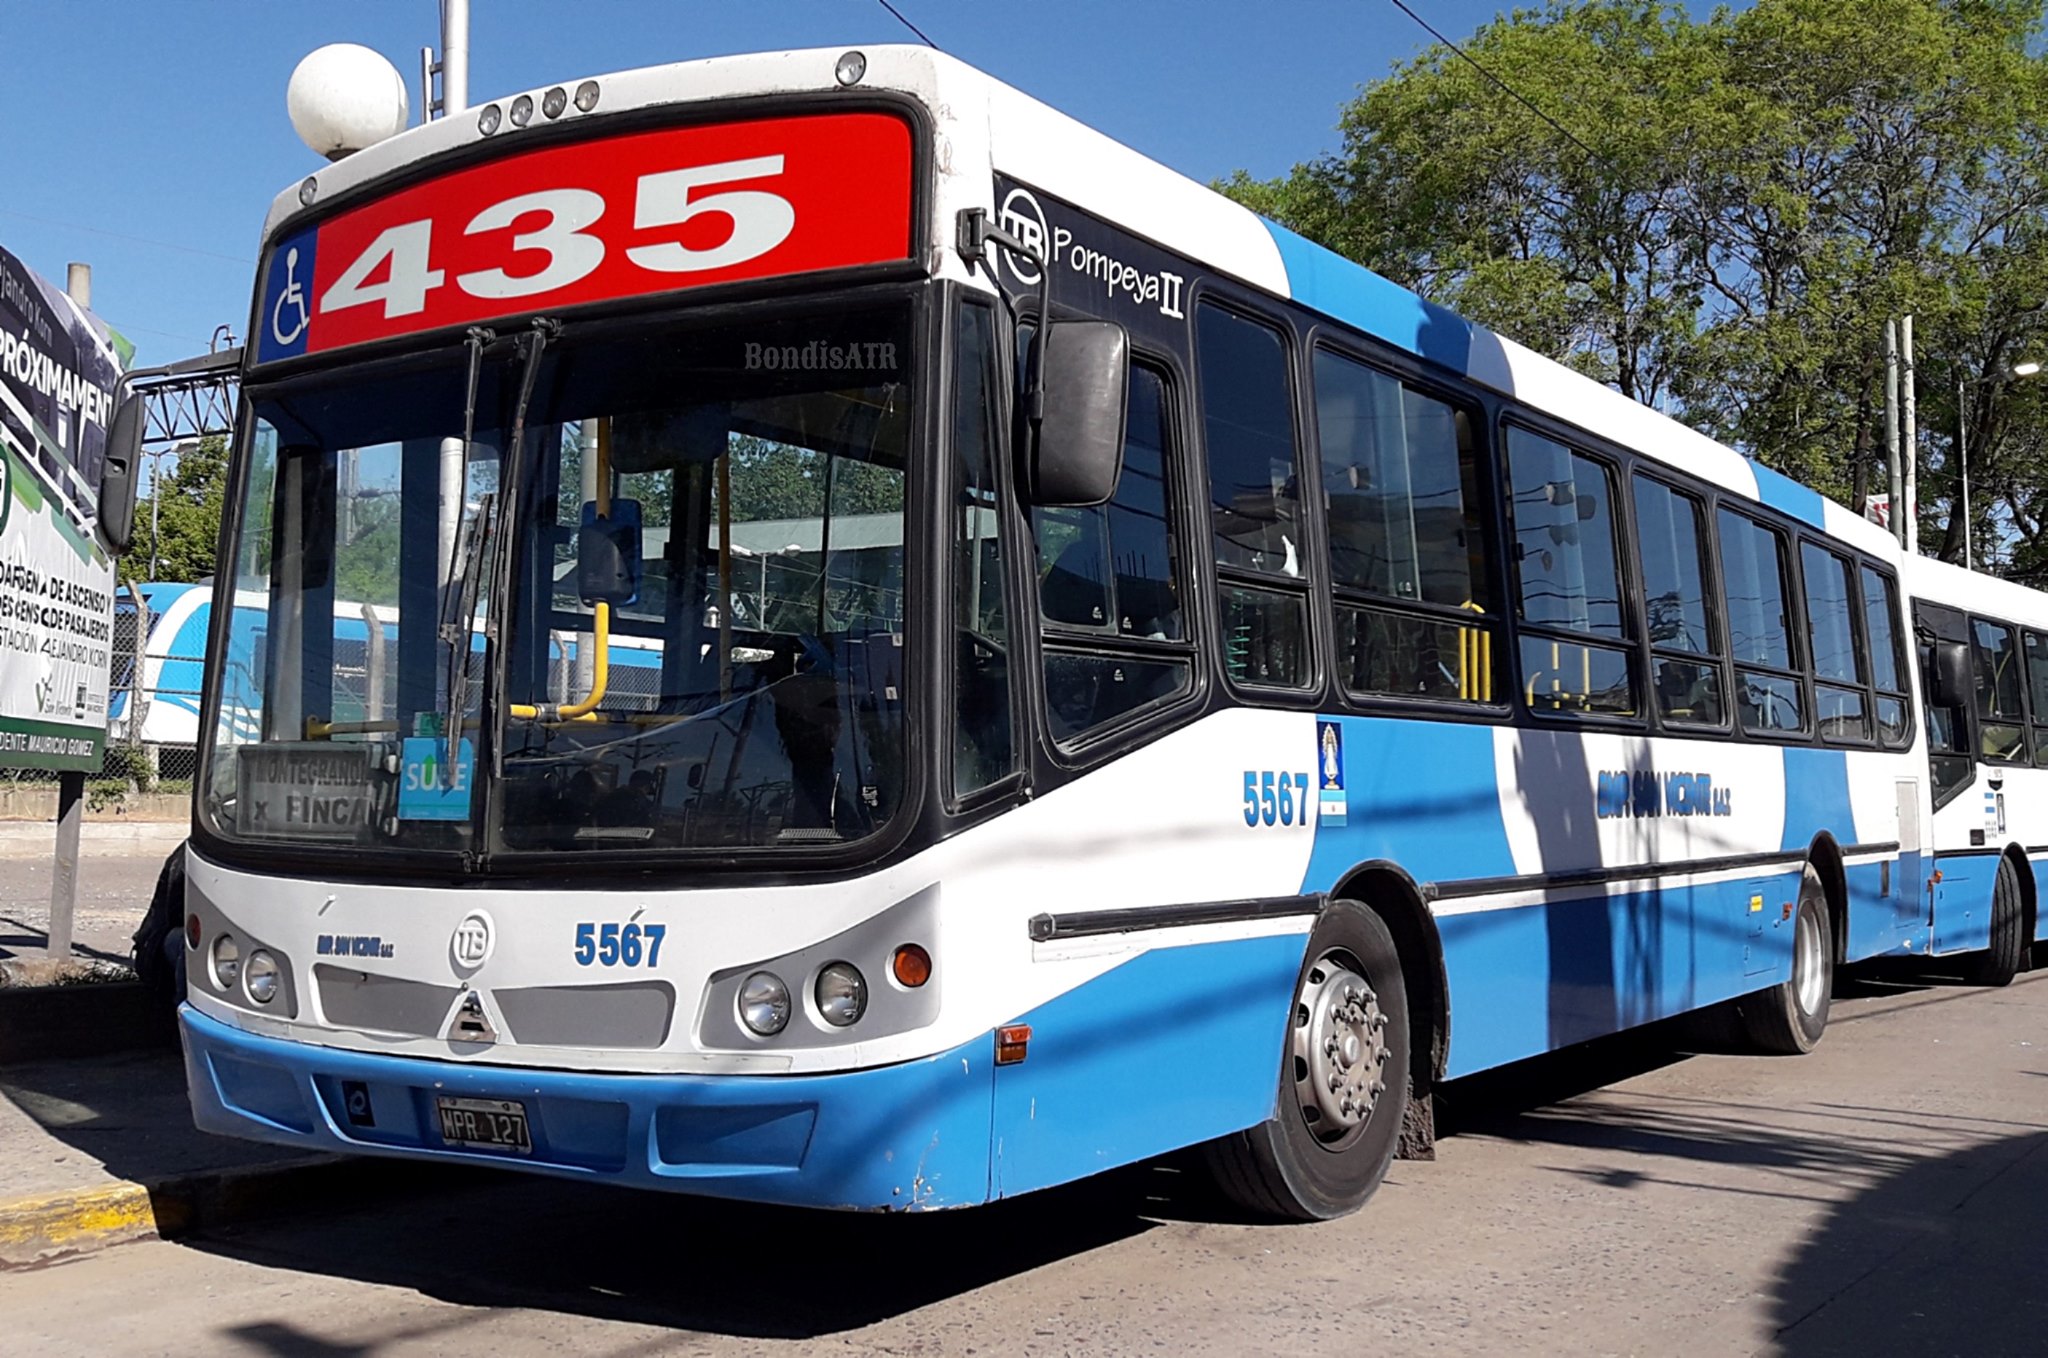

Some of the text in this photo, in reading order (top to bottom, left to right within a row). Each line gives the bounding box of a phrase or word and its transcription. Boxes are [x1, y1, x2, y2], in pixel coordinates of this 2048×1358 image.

[319, 154, 796, 319] 435
[0, 256, 34, 324] jandro
[1054, 226, 1184, 320] Pompeya II
[0, 594, 110, 642] ESCENSO DE PASAJEROS
[50, 577, 65, 601] DE
[65, 582, 106, 614] ASCENSO
[106, 596, 112, 615] Y
[28, 735, 67, 755] MAURICIO
[1243, 770, 1309, 828] 5567
[574, 922, 667, 969] 5567
[487, 1111, 522, 1144] 127
